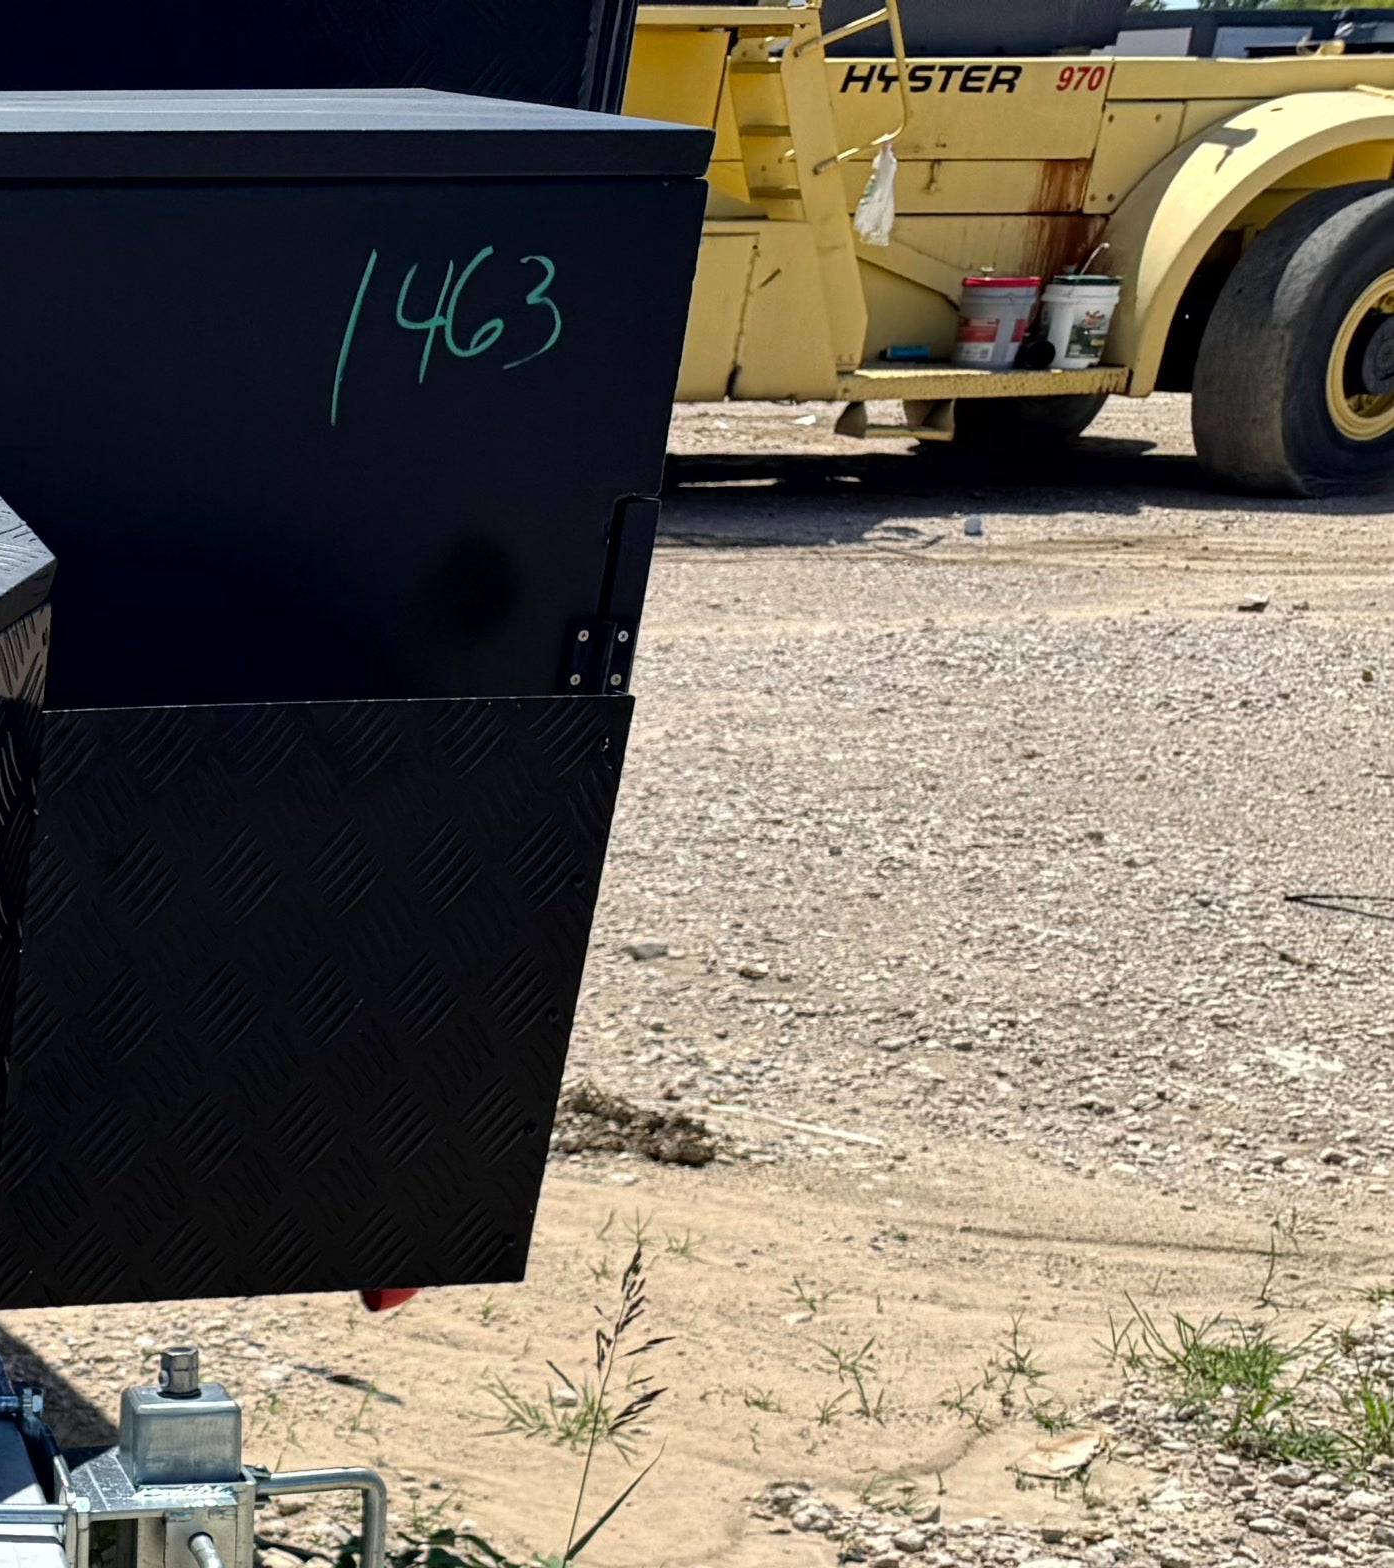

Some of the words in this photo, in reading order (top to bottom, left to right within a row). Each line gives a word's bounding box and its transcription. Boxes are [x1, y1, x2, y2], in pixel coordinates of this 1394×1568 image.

[840, 64, 1023, 93] HYSTER
[1056, 66, 1106, 91] 970
[330, 246, 562, 426] 1463
